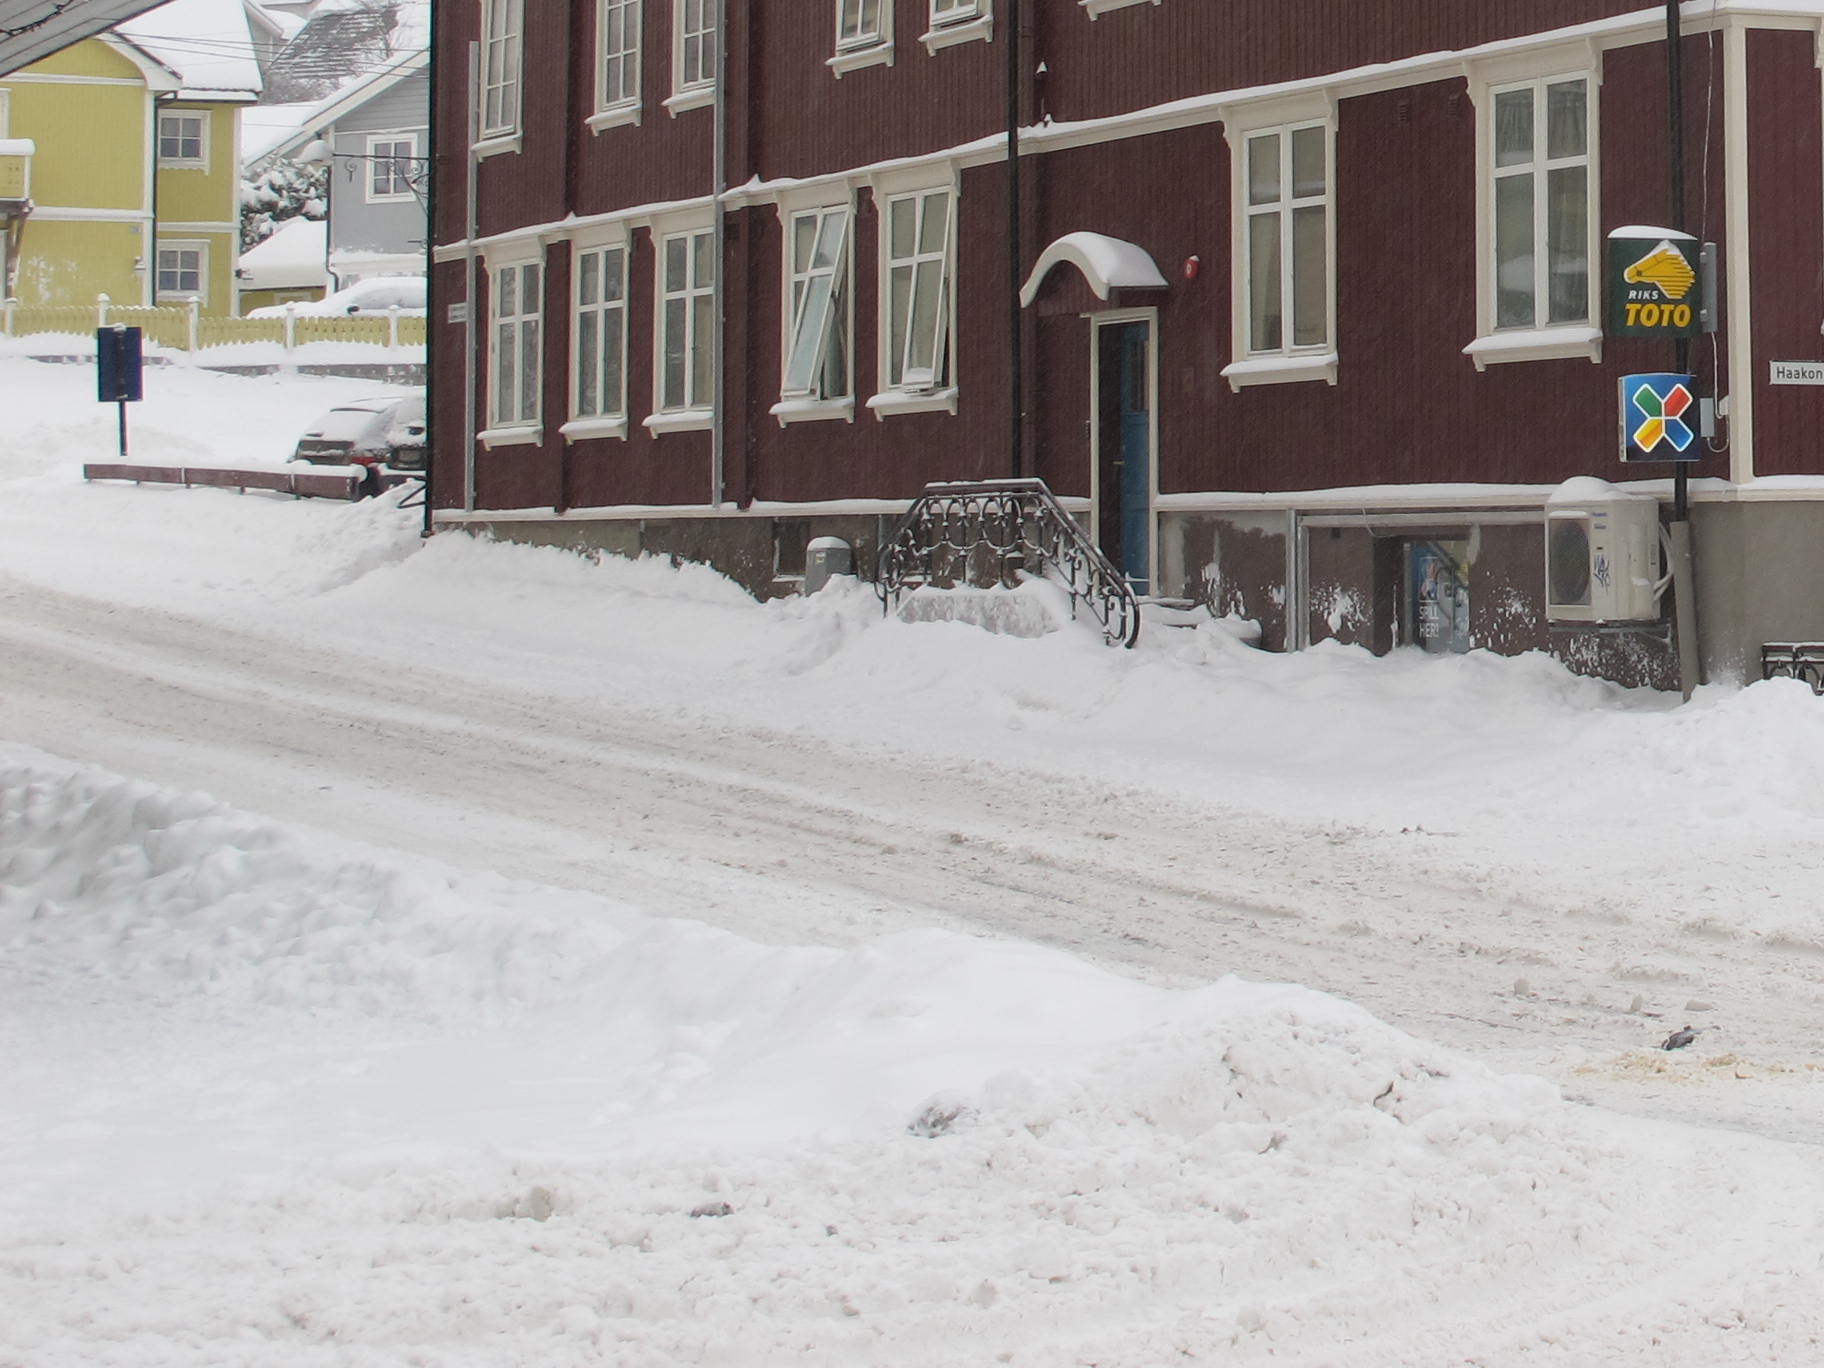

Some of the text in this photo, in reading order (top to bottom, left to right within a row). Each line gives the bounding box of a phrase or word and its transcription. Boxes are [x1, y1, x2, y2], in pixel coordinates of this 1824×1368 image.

[1628, 289, 1659, 300] RIKS
[1624, 303, 1692, 328] TOTO
[1776, 366, 1823, 380] Haakon
